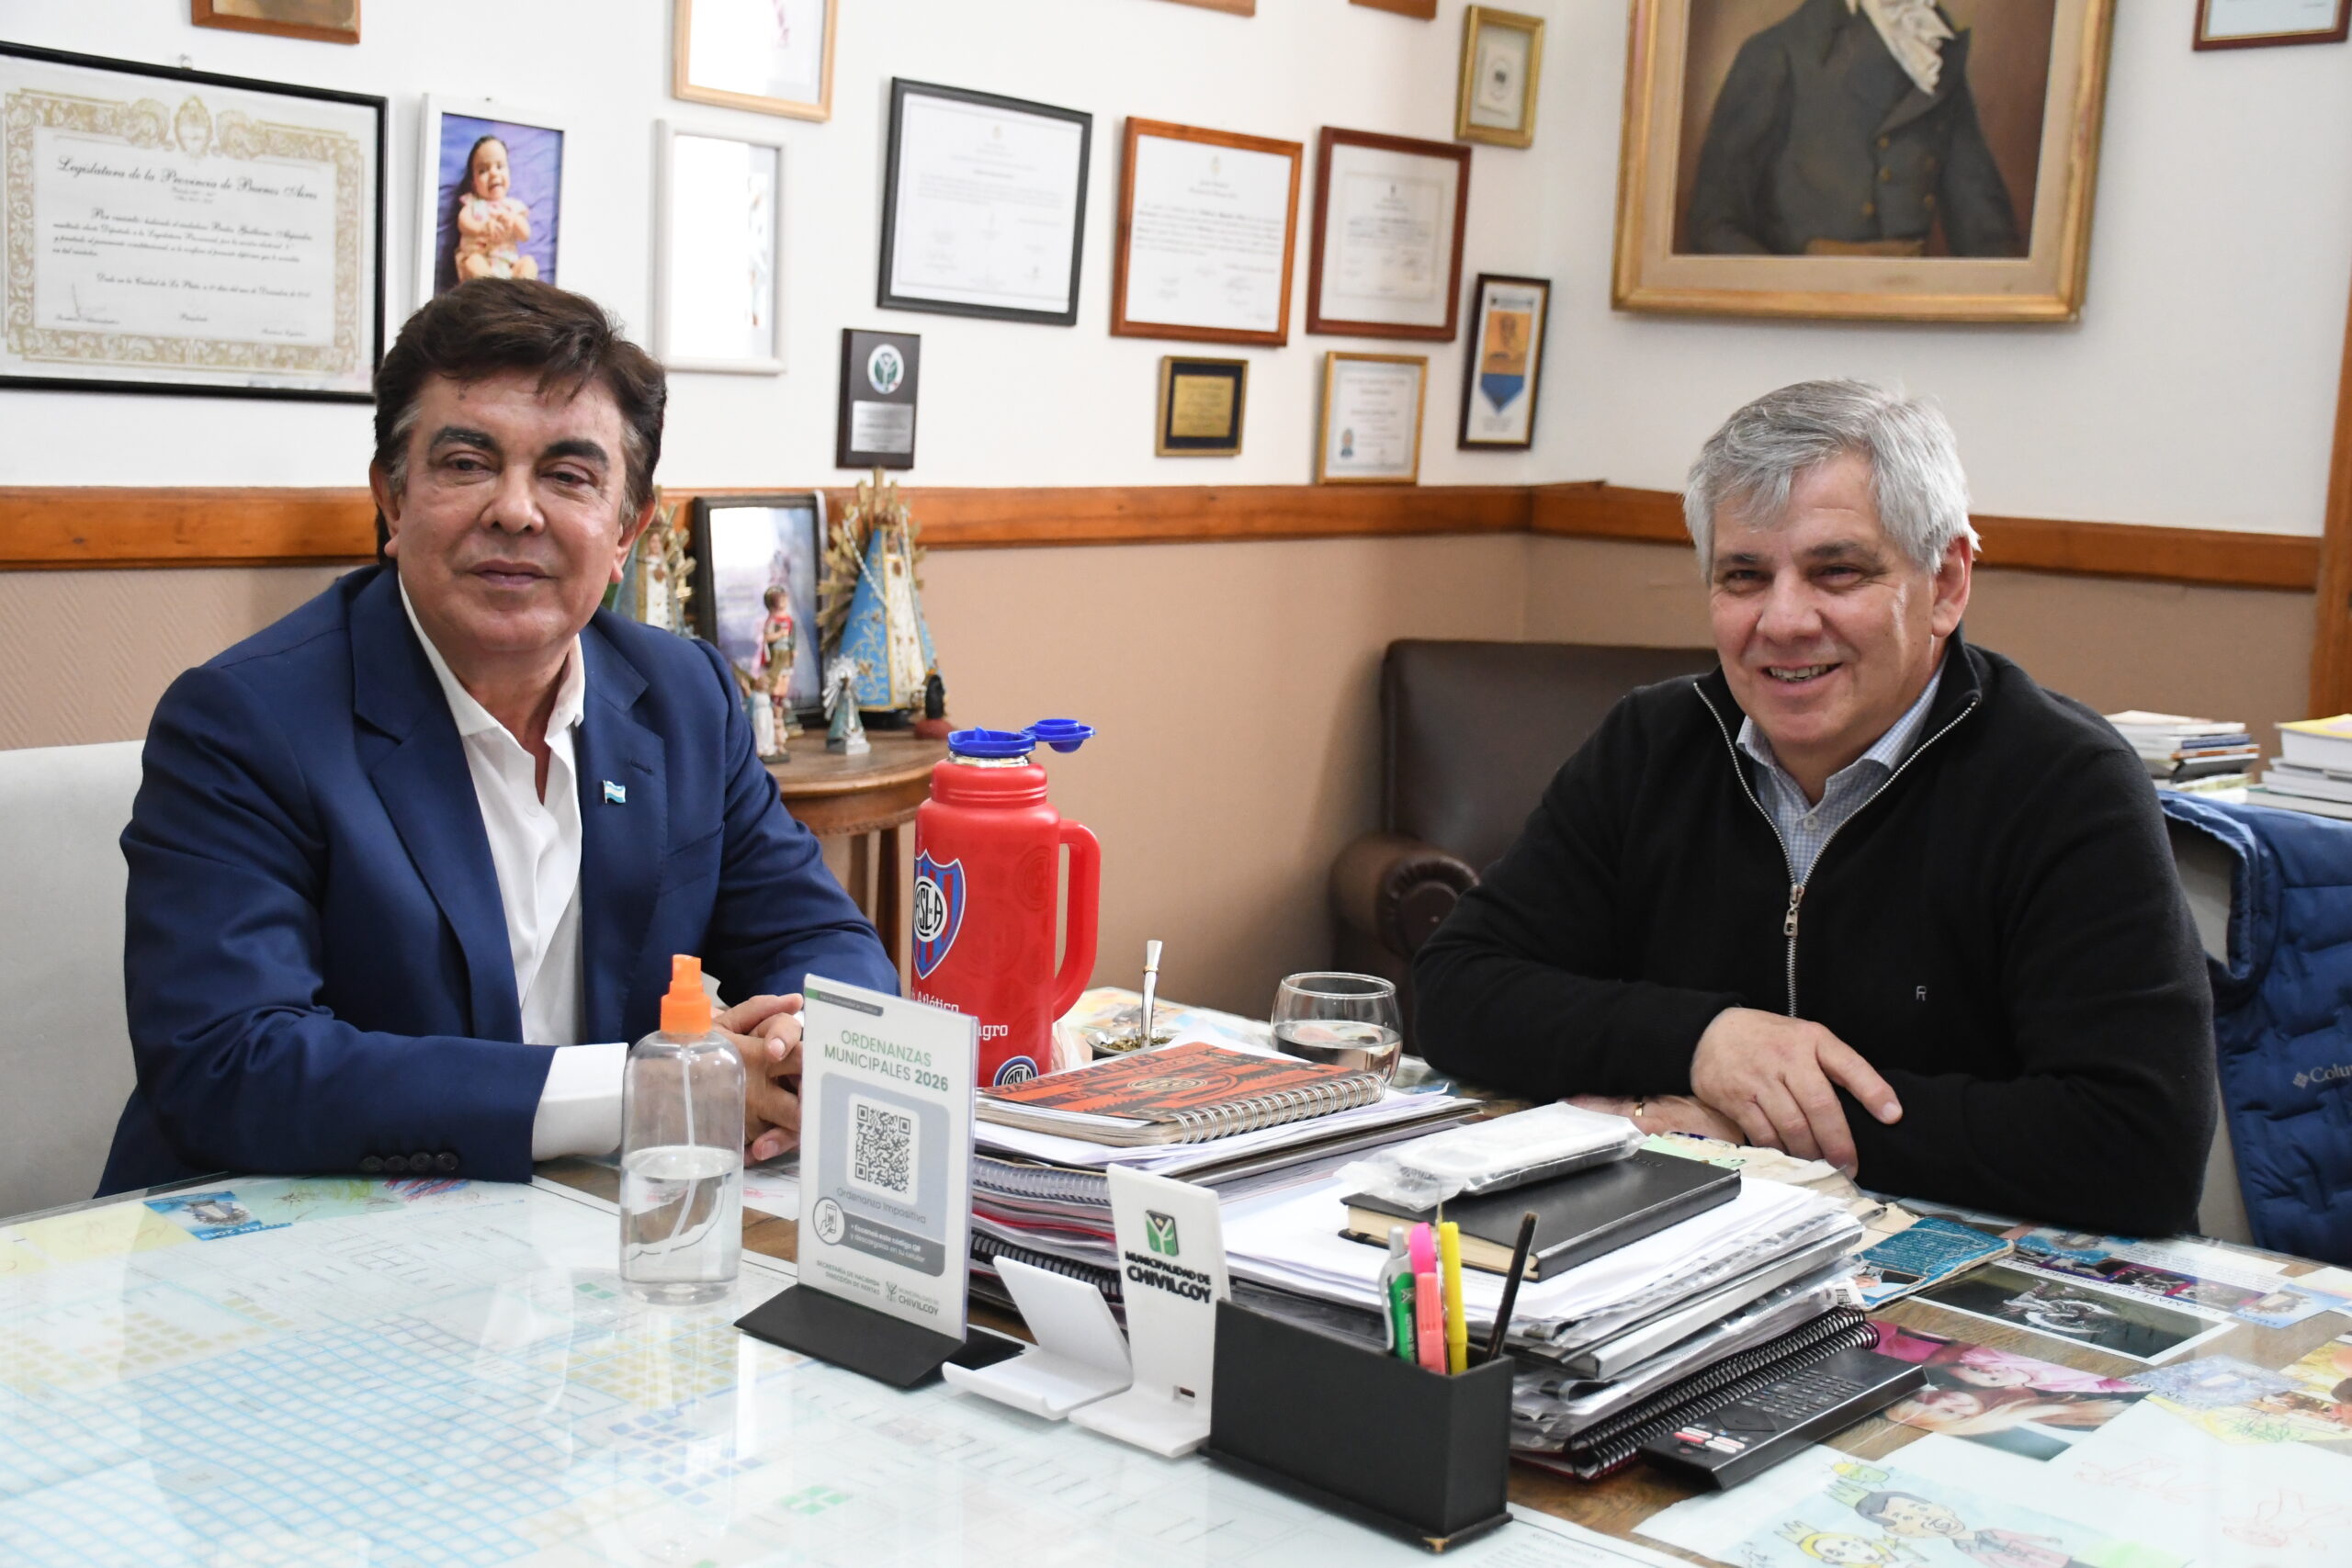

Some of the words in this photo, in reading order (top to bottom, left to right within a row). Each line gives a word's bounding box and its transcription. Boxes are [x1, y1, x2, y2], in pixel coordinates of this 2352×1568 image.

[841, 1030, 932, 1067] ORDENANZAS
[824, 1043, 910, 1081] MUNICIPALES
[914, 1069, 949, 1092] 2026
[2310, 1064, 2352, 1083] Colu
[836, 1187, 882, 1210] Ordenanza
[883, 1201, 926, 1224] Impositiva
[1125, 1251, 1196, 1280] MUNICIPALIDAD
[1196, 1272, 1211, 1286] DE
[1126, 1266, 1212, 1303] CHIVILCOY
[898, 1295, 939, 1315] CHIVILCOY
[2111, 1285, 2138, 1297] fue
[2143, 1292, 2185, 1308] MATE
